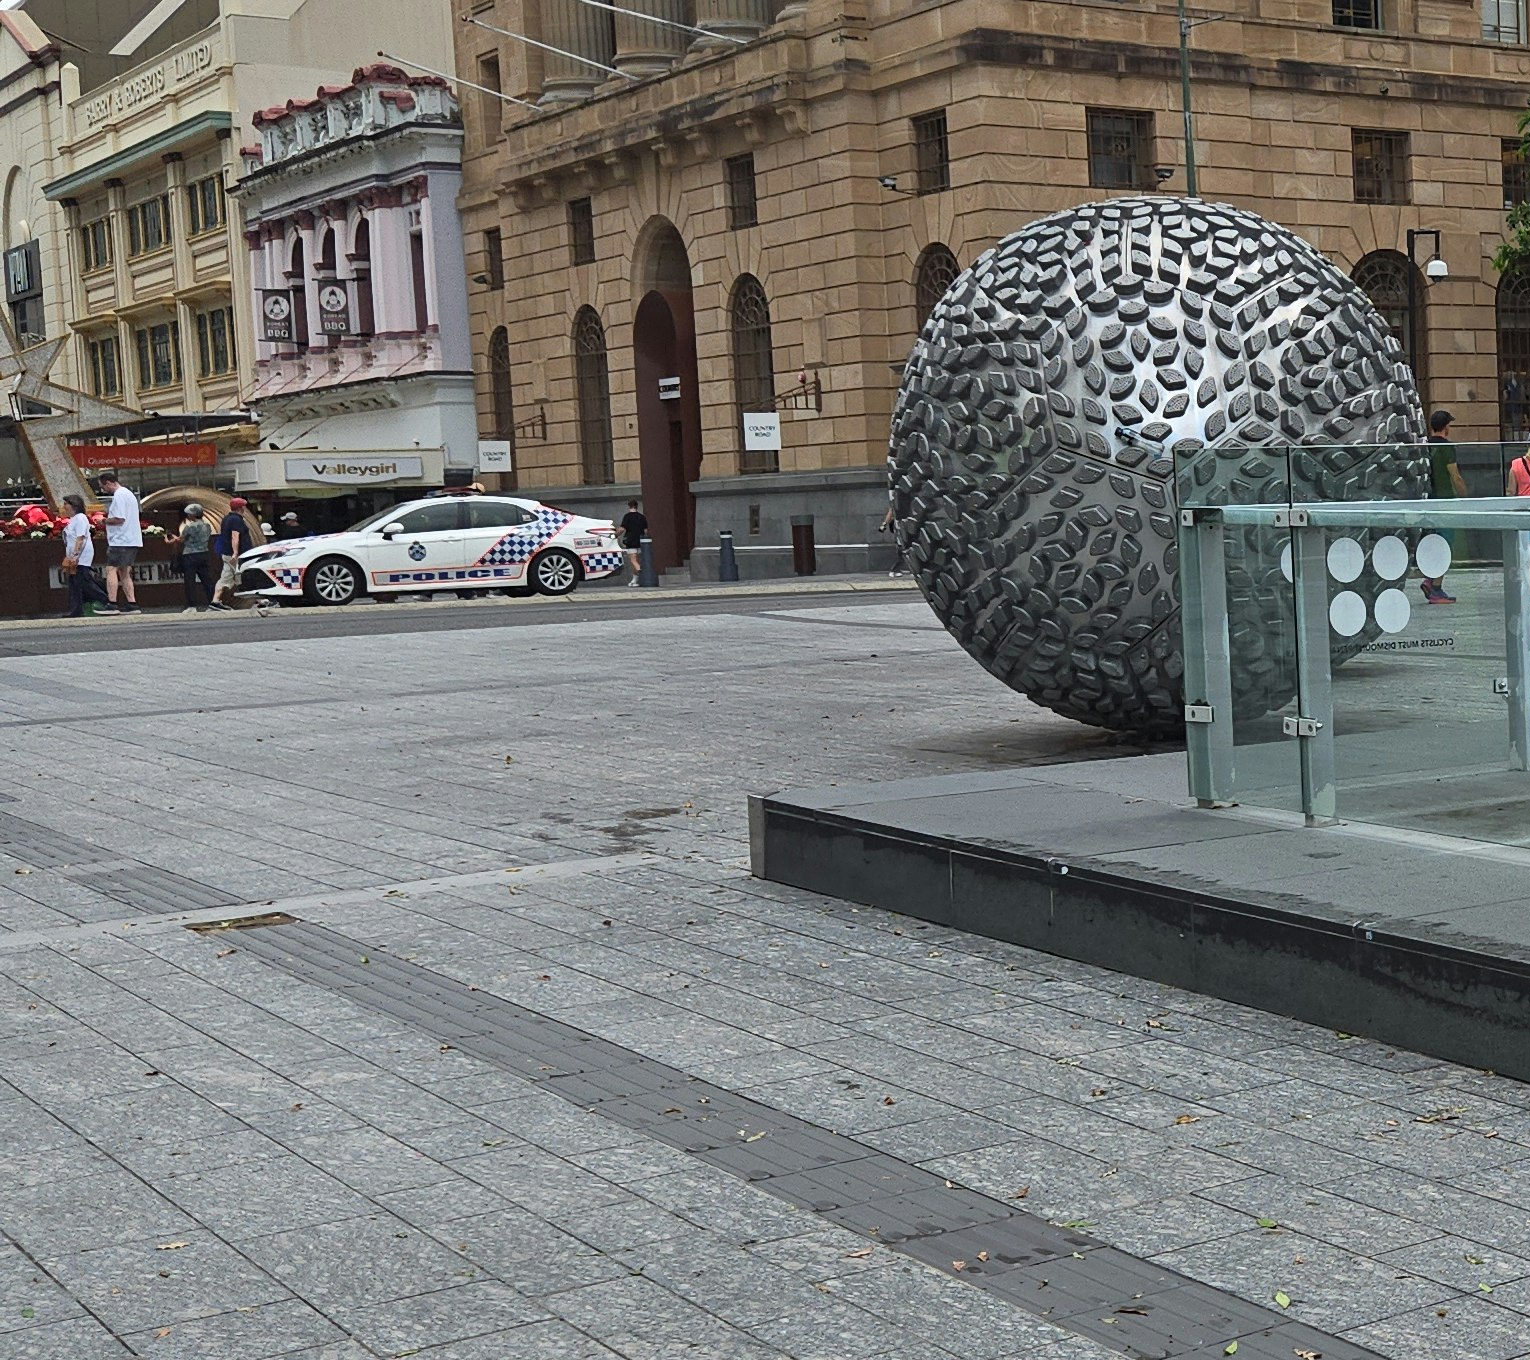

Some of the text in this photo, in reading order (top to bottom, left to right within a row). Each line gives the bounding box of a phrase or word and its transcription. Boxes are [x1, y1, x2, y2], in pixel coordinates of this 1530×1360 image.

[324, 322, 346, 330] BBQ
[267, 329, 289, 338] BBQ
[88, 455, 193, 465] Queen Street bus station
[312, 463, 397, 477] Valleygirl
[389, 568, 512, 582] POLICE
